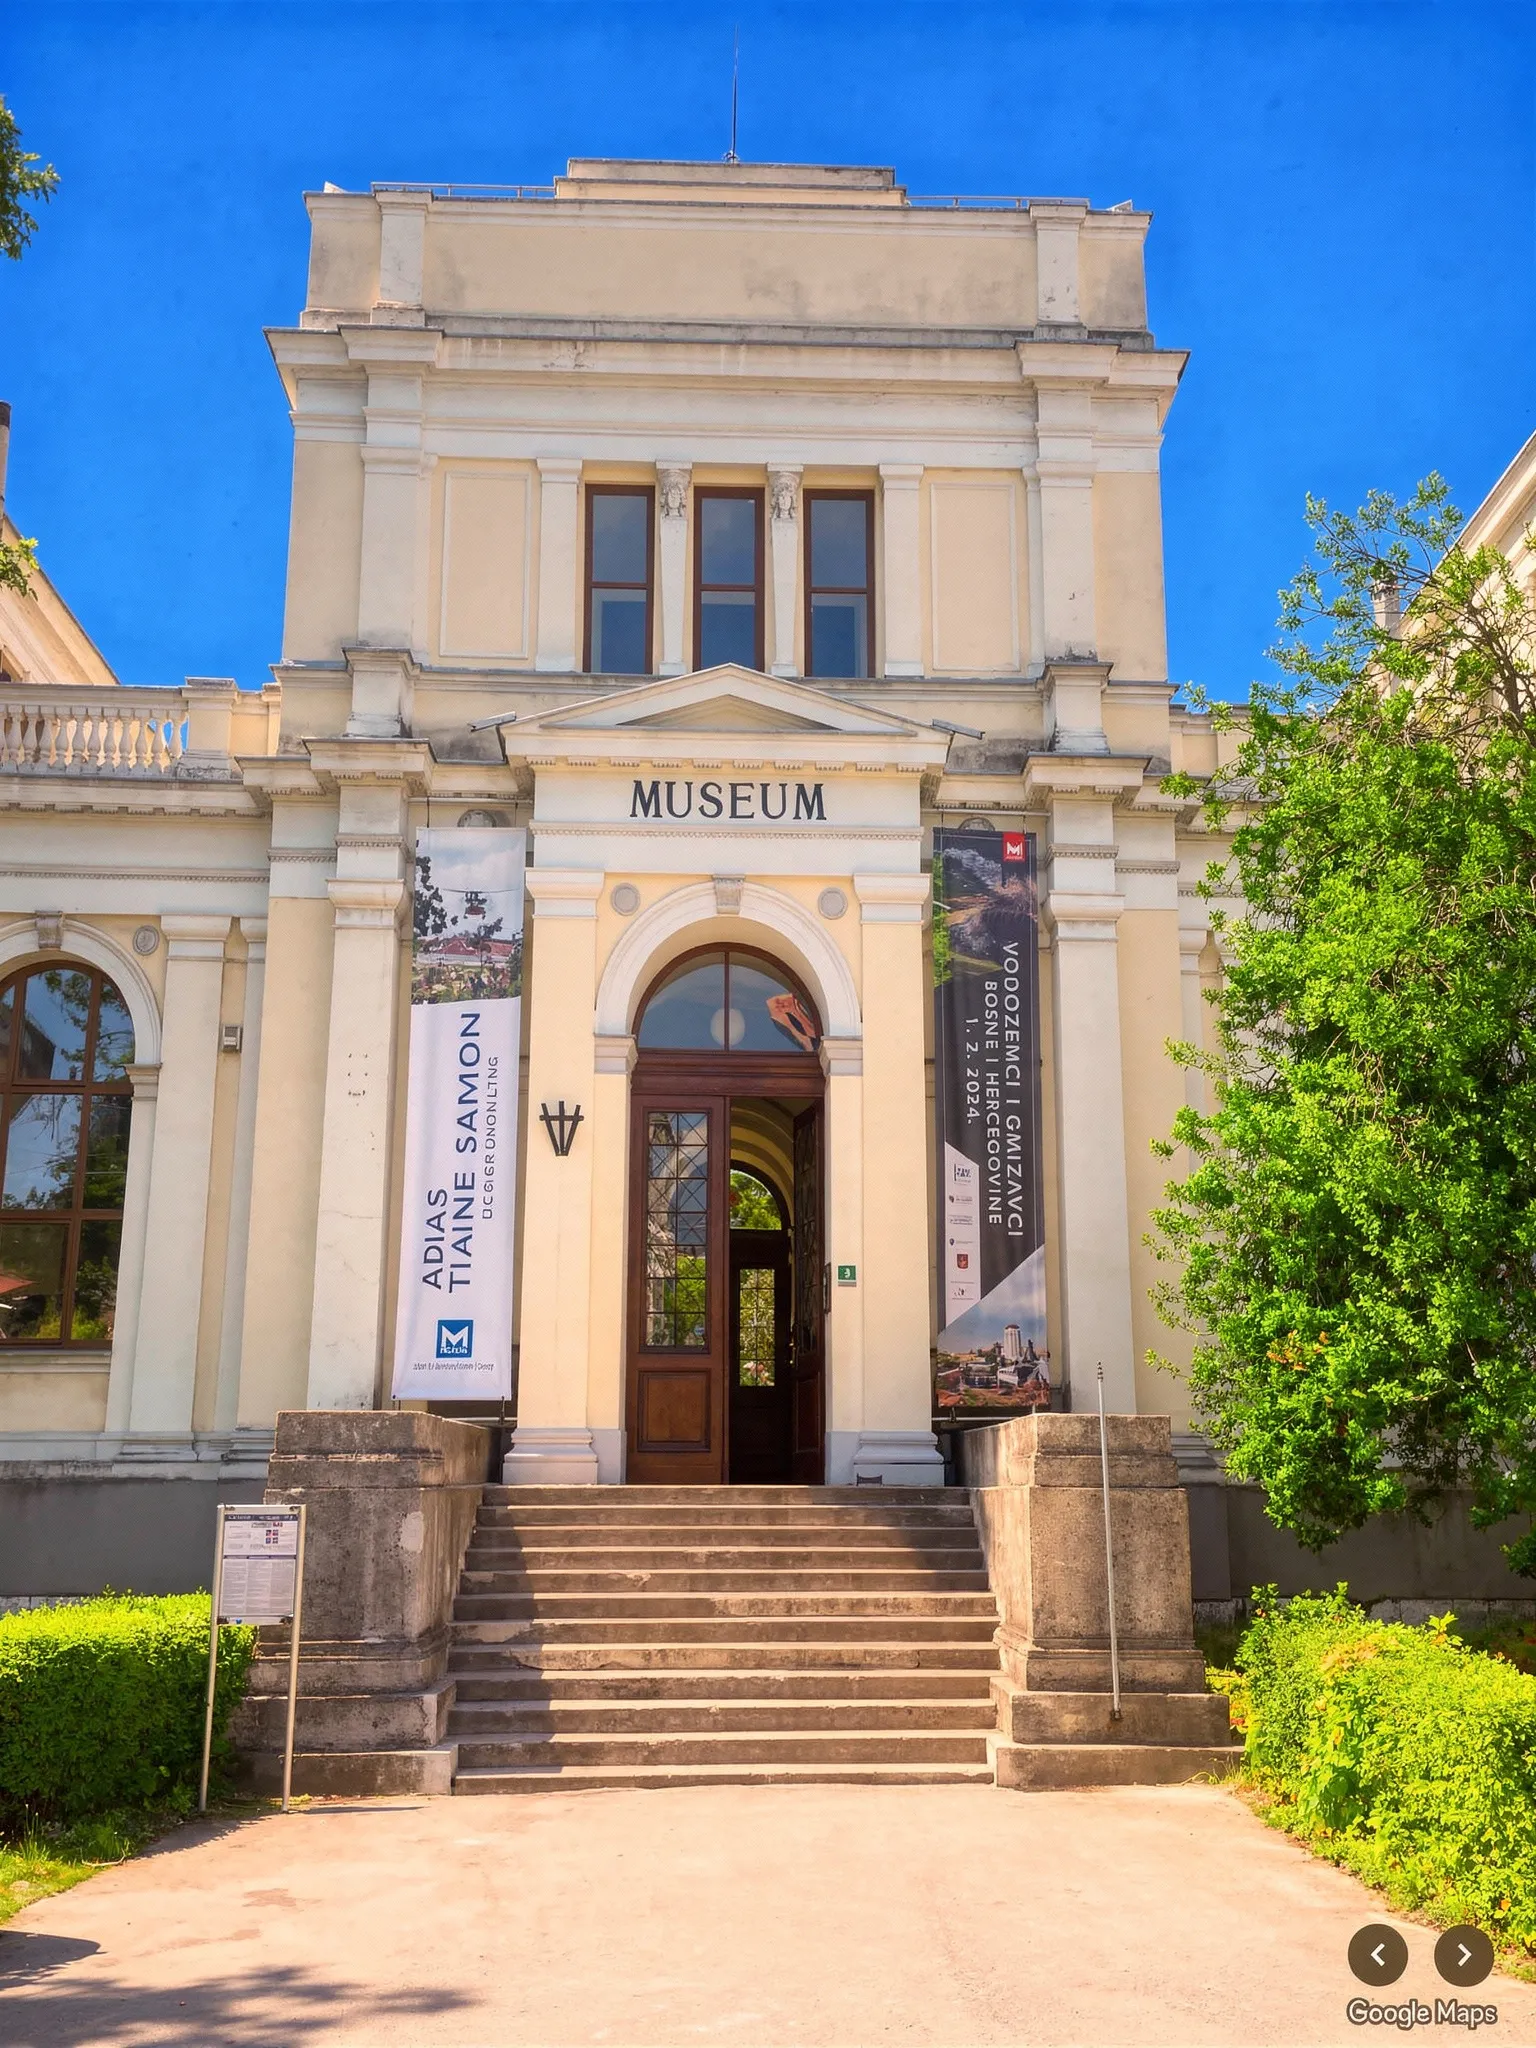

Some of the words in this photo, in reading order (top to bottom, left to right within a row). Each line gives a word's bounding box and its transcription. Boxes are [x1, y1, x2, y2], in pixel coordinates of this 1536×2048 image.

[629, 779, 827, 821] MUSEUM
[966, 1041, 979, 1059] 2.
[984, 981, 999, 1049] BOSNE
[1002, 942, 1021, 1086] VODOZEMCI
[455, 1013, 481, 1154] SAMON
[966, 1067, 981, 1124] 2024.
[985, 1072, 1002, 1224] HERCEGOVINE
[1005, 1114, 1024, 1236] GMIZAVCI
[421, 1188, 448, 1290] ADIAS
[448, 1172, 476, 1294] TIAINE
